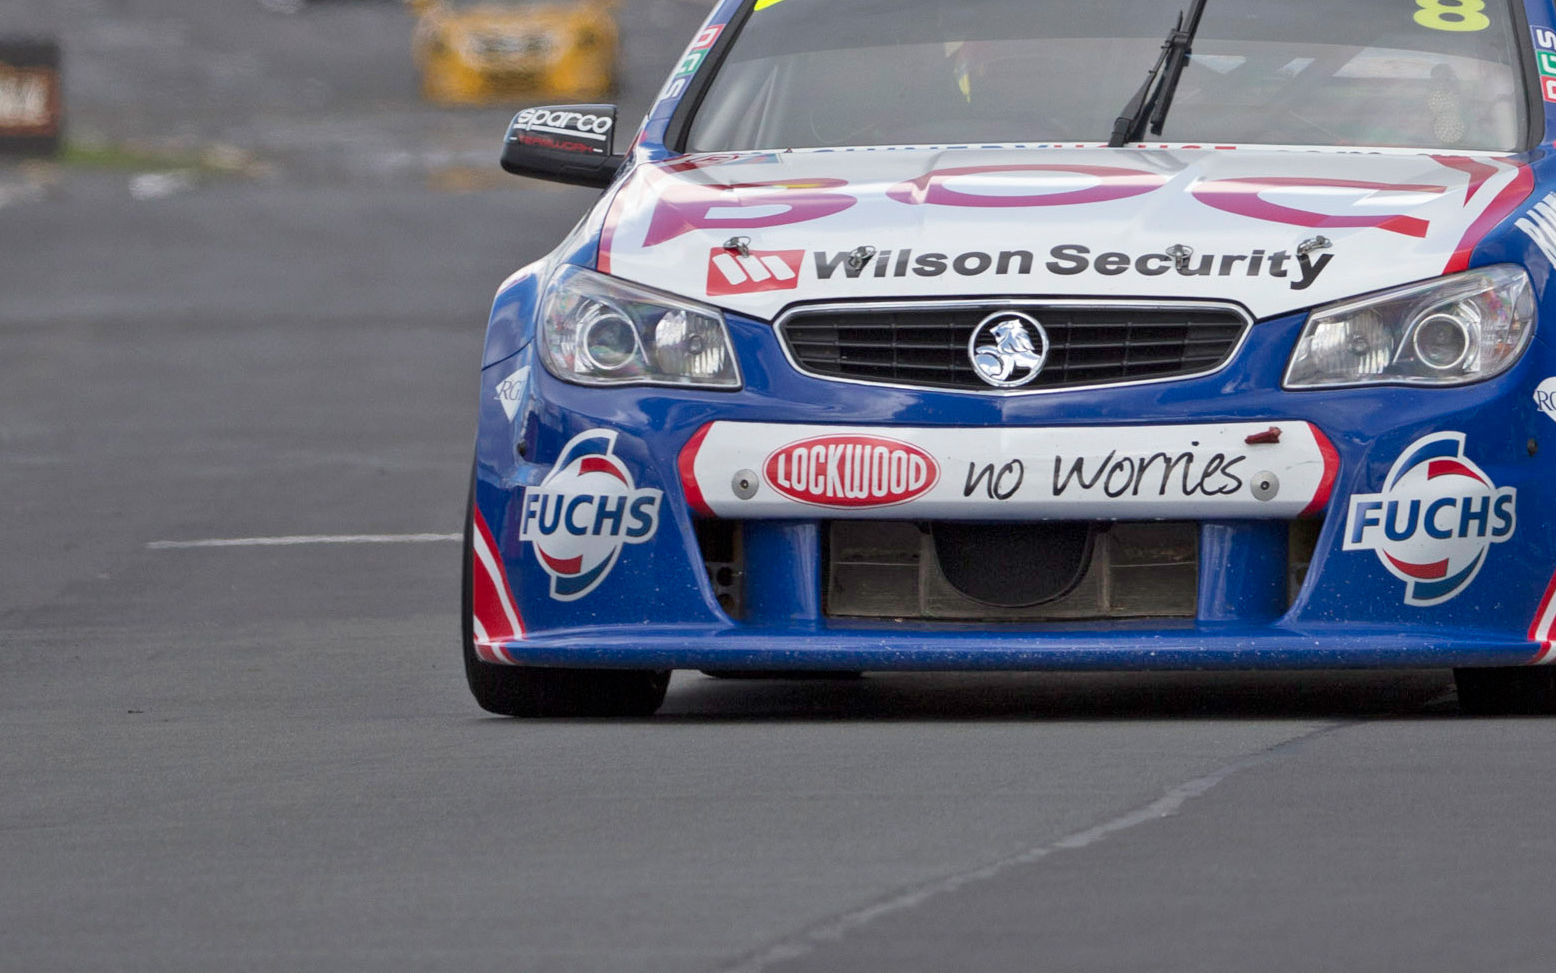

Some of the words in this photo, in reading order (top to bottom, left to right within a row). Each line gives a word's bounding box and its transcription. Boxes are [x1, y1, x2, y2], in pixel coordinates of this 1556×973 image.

[660, 26, 719, 100] DGS
[517, 108, 612, 134] sparco
[642, 163, 1448, 248] BOC
[813, 249, 1041, 280] Wilson
[1045, 241, 1335, 290] Security
[777, 444, 928, 500] LOCKWOOD
[963, 459, 1024, 500] no
[522, 493, 656, 538] FUCHS
[1351, 493, 1514, 544] FUCHS
